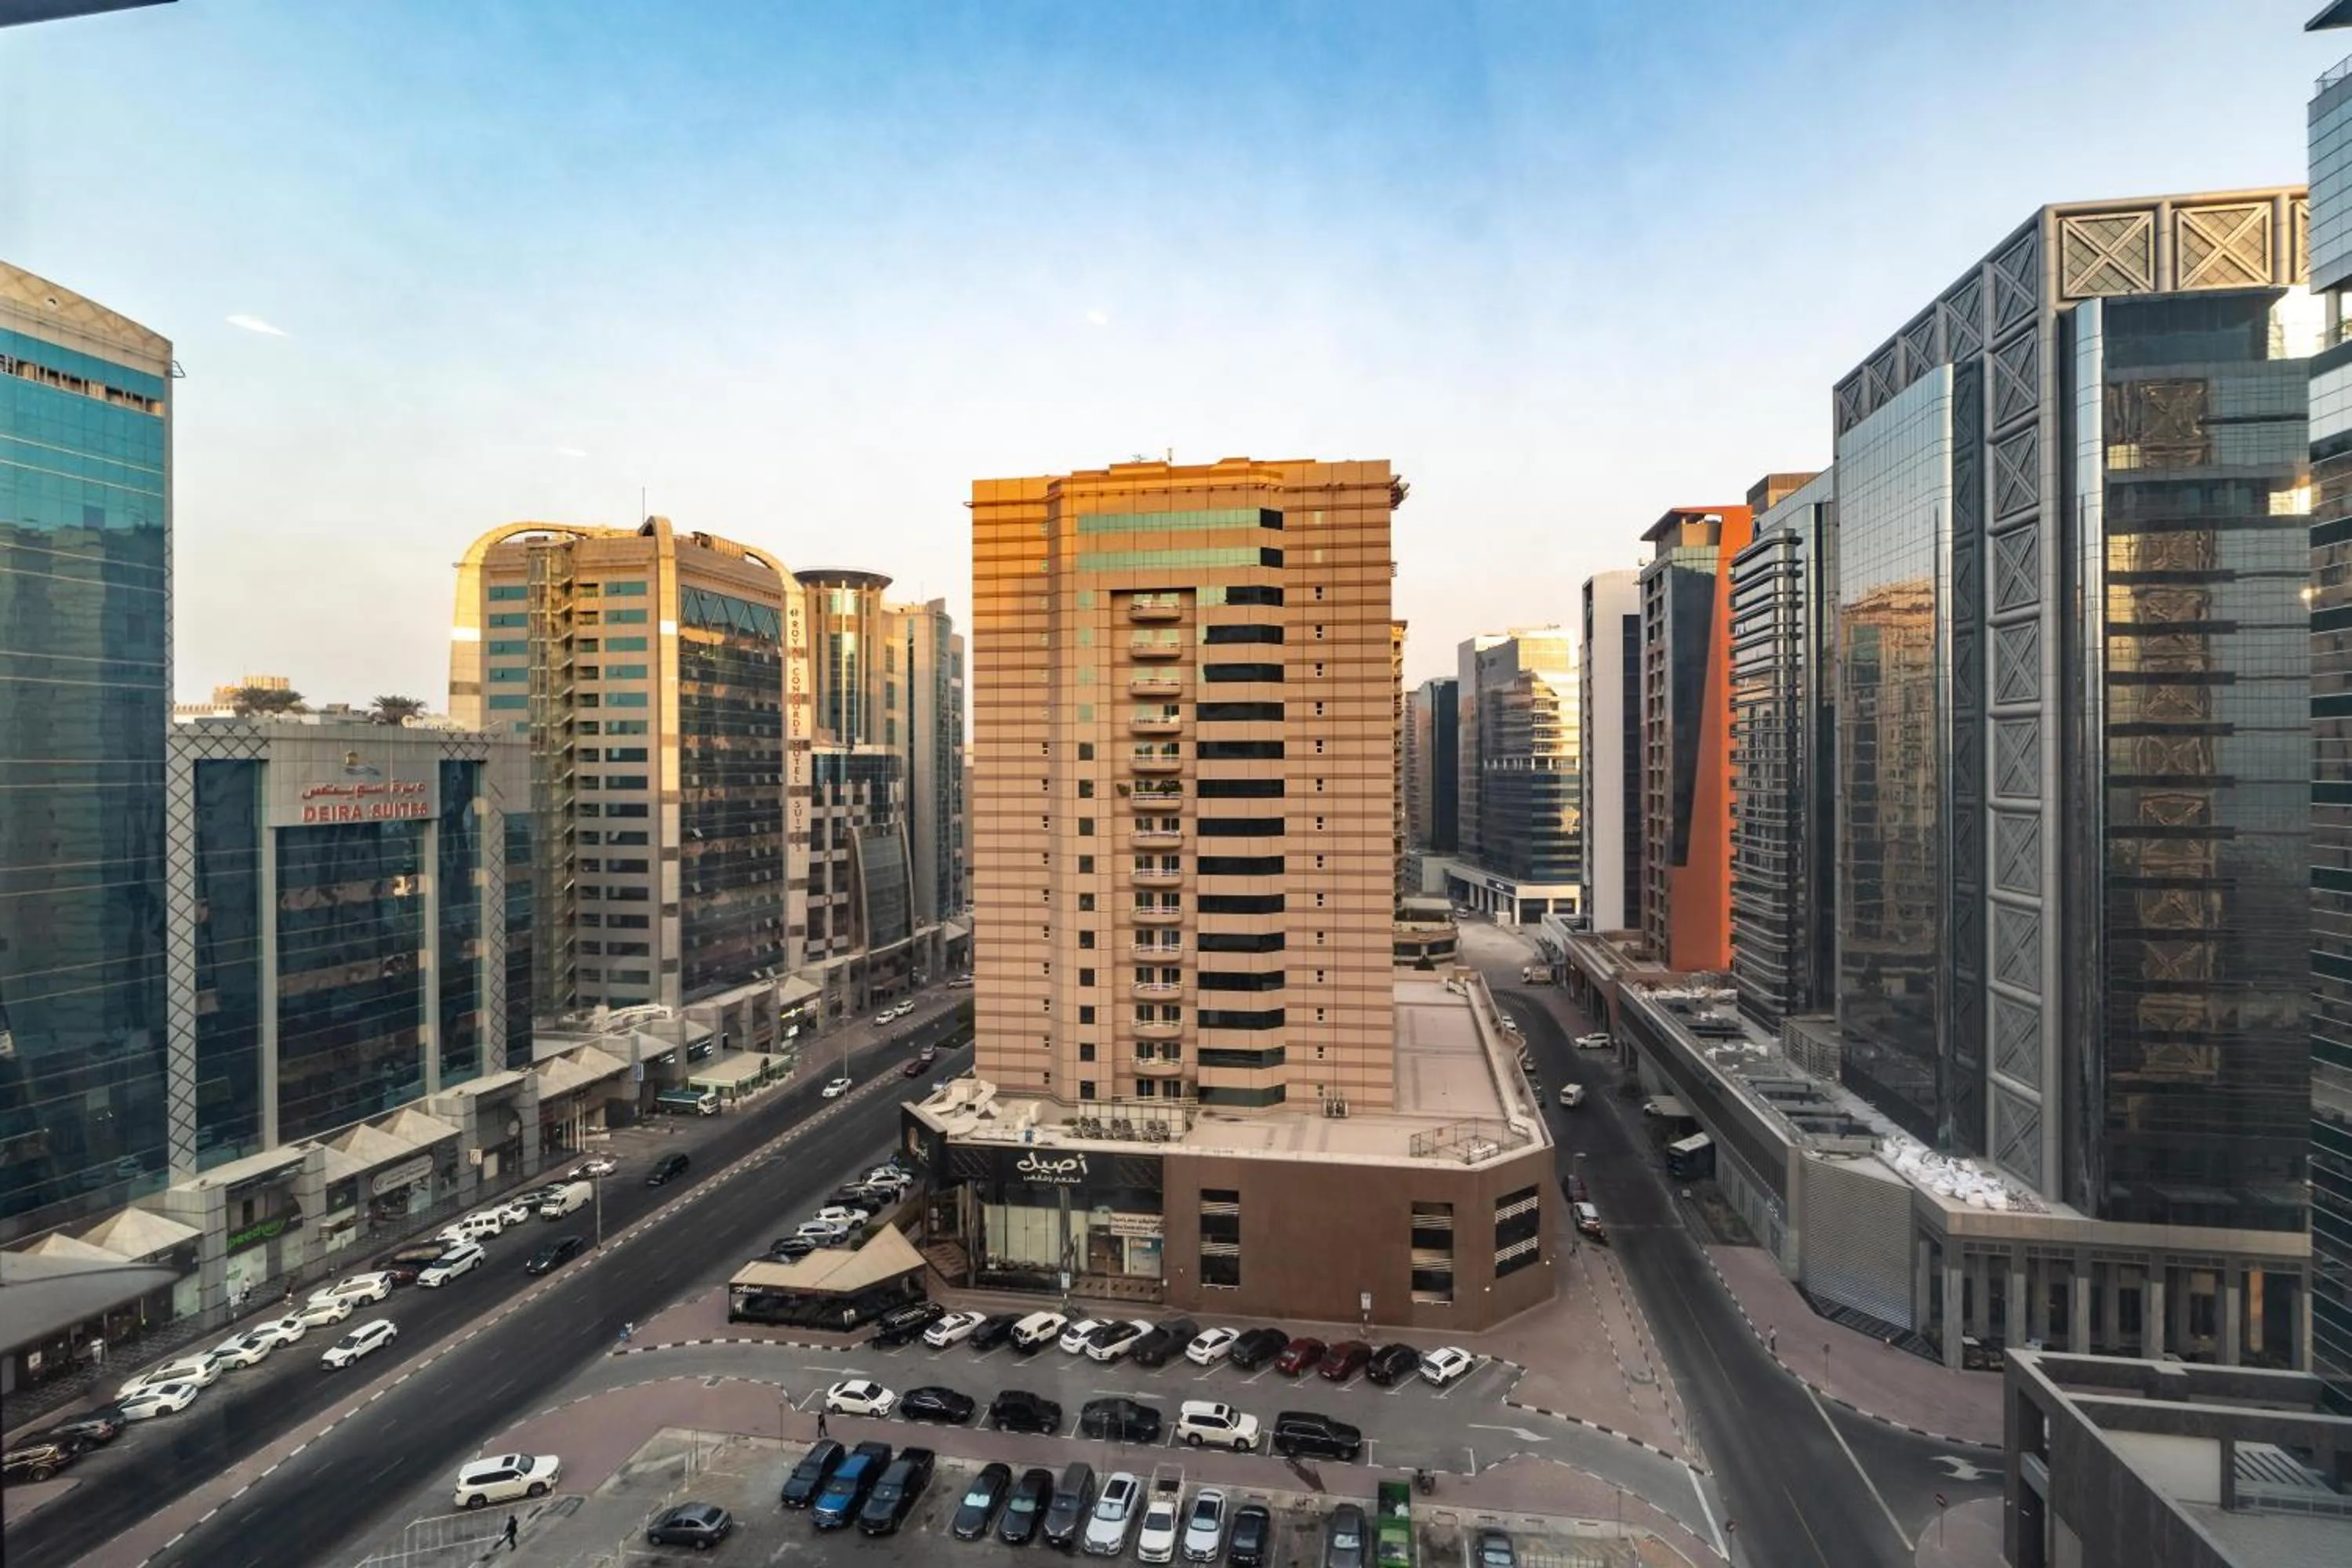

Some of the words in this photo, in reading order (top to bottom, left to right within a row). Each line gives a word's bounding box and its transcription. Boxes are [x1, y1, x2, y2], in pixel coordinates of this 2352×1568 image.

[791, 620, 800, 663] ROYAL
[791, 667, 801, 736] CONCORDE
[793, 740, 801, 783] HOTEL
[302, 804, 362, 823] DEIRA
[370, 802, 429, 818] SUITES
[1016, 1152, 1088, 1174] أصيل
